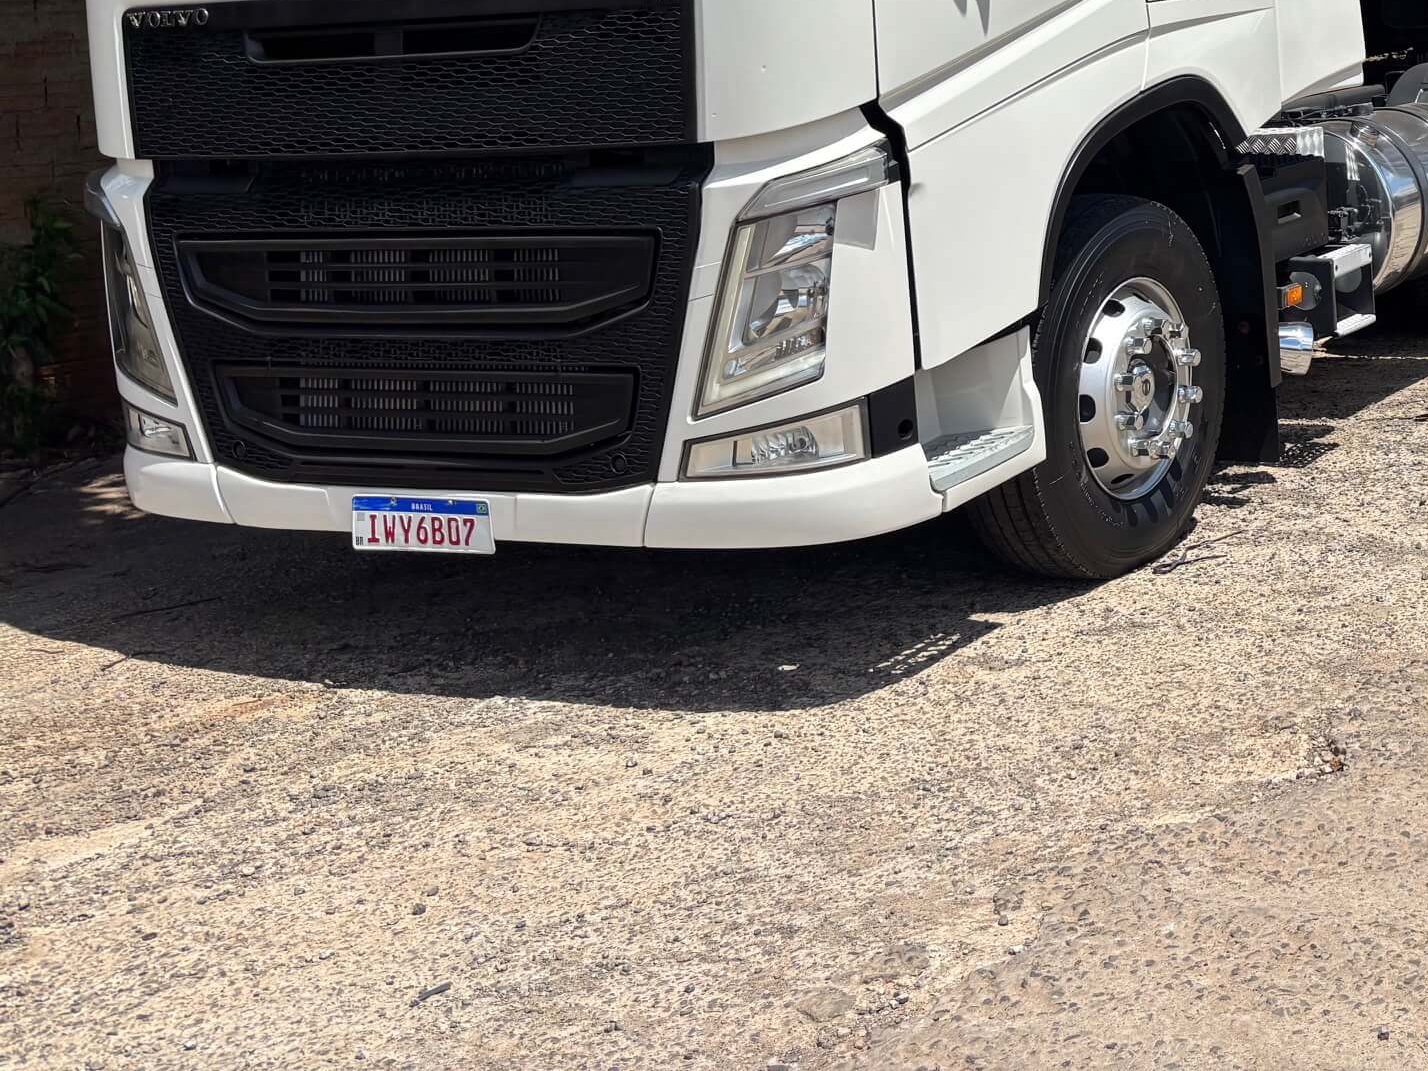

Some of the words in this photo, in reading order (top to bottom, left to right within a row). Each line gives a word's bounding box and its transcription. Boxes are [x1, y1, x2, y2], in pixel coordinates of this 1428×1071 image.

[127, 8, 208, 27] VOLVO
[411, 503, 433, 511] BRASIL
[368, 514, 475, 546] IWY6B07
